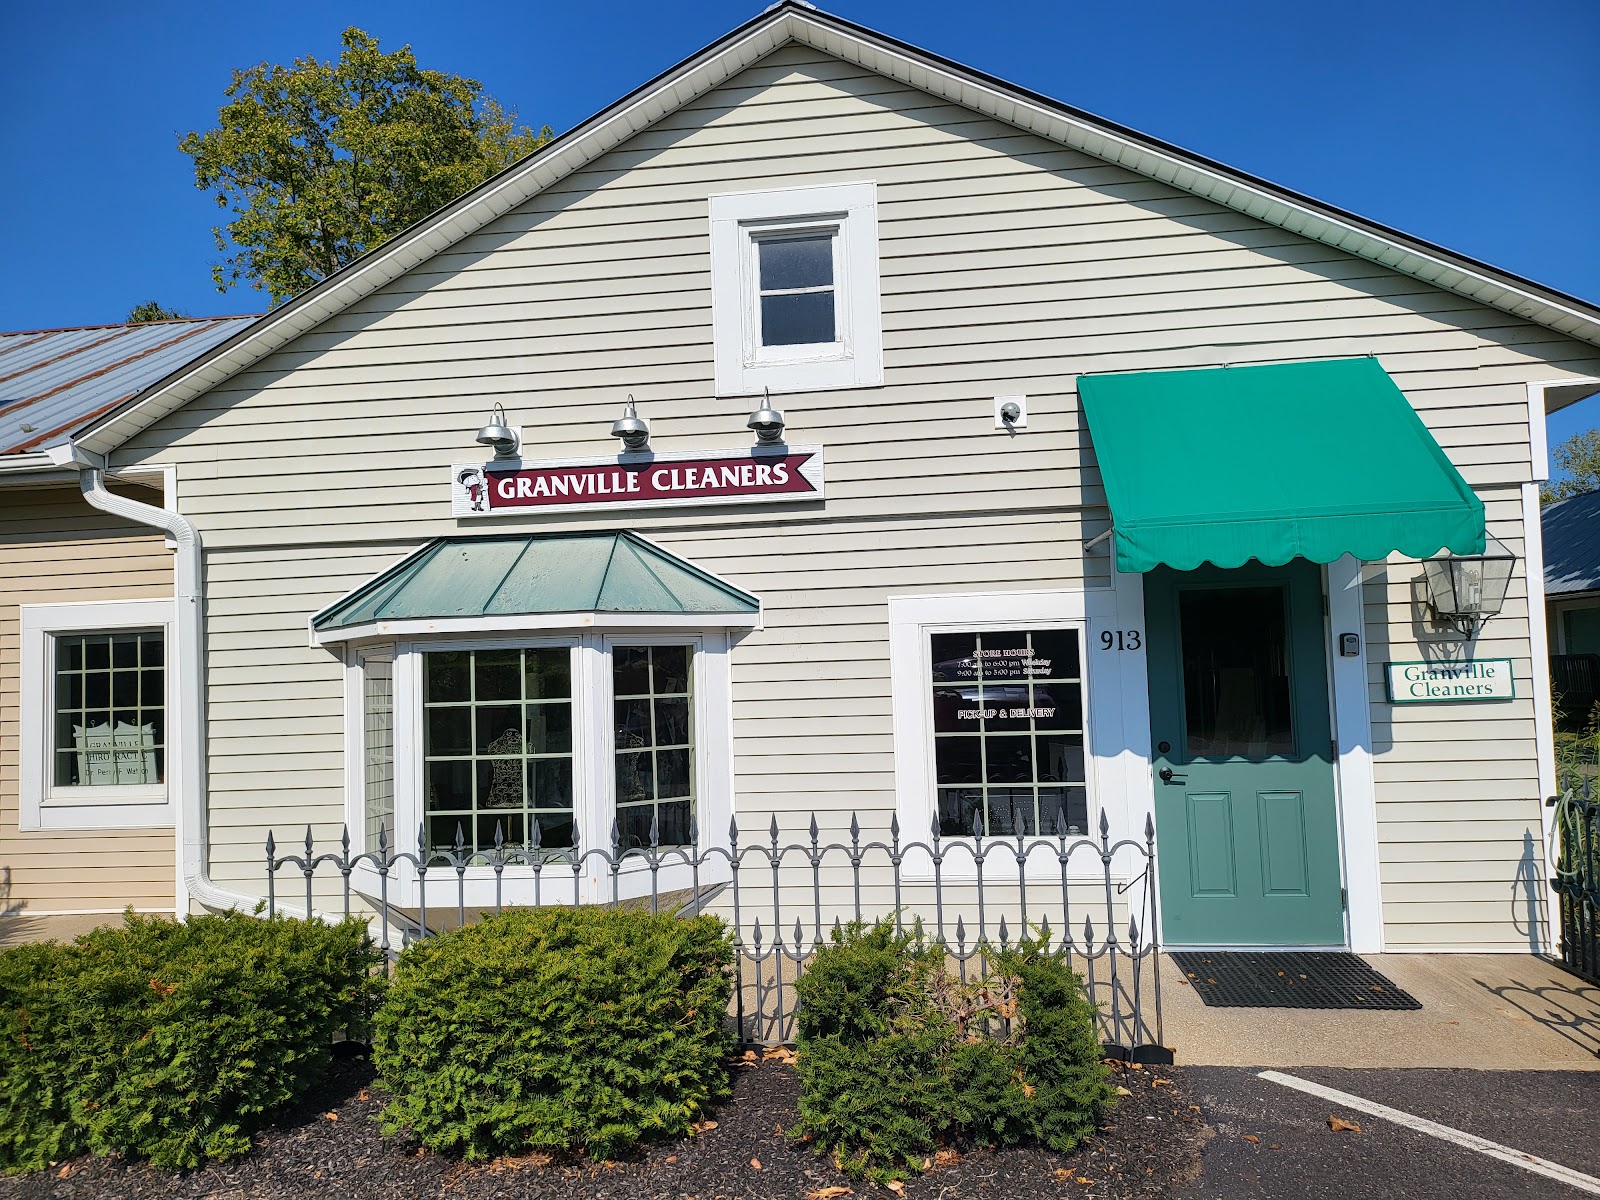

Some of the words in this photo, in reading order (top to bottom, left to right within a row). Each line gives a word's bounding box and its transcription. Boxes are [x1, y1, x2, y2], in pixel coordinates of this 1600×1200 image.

[497, 471, 641, 501] GRANVILLE
[651, 463, 789, 492] CLEANERS
[1101, 630, 1142, 651] 913
[972, 649, 1002, 658] STORE
[1003, 648, 1036, 657] HOURS
[1009, 660, 1021, 668] pm
[957, 669, 972, 677] 9:00
[1009, 669, 1021, 677] pm
[1022, 667, 1053, 676] Saturday
[1404, 663, 1496, 682] Granville
[1409, 682, 1494, 697] Cleaners
[957, 708, 998, 720] PICK-UP
[999, 708, 1008, 719] &
[1009, 707, 1056, 719] DELIVERY
[84, 752, 149, 762] HIRORACTC
[126, 767, 149, 775] Waton
